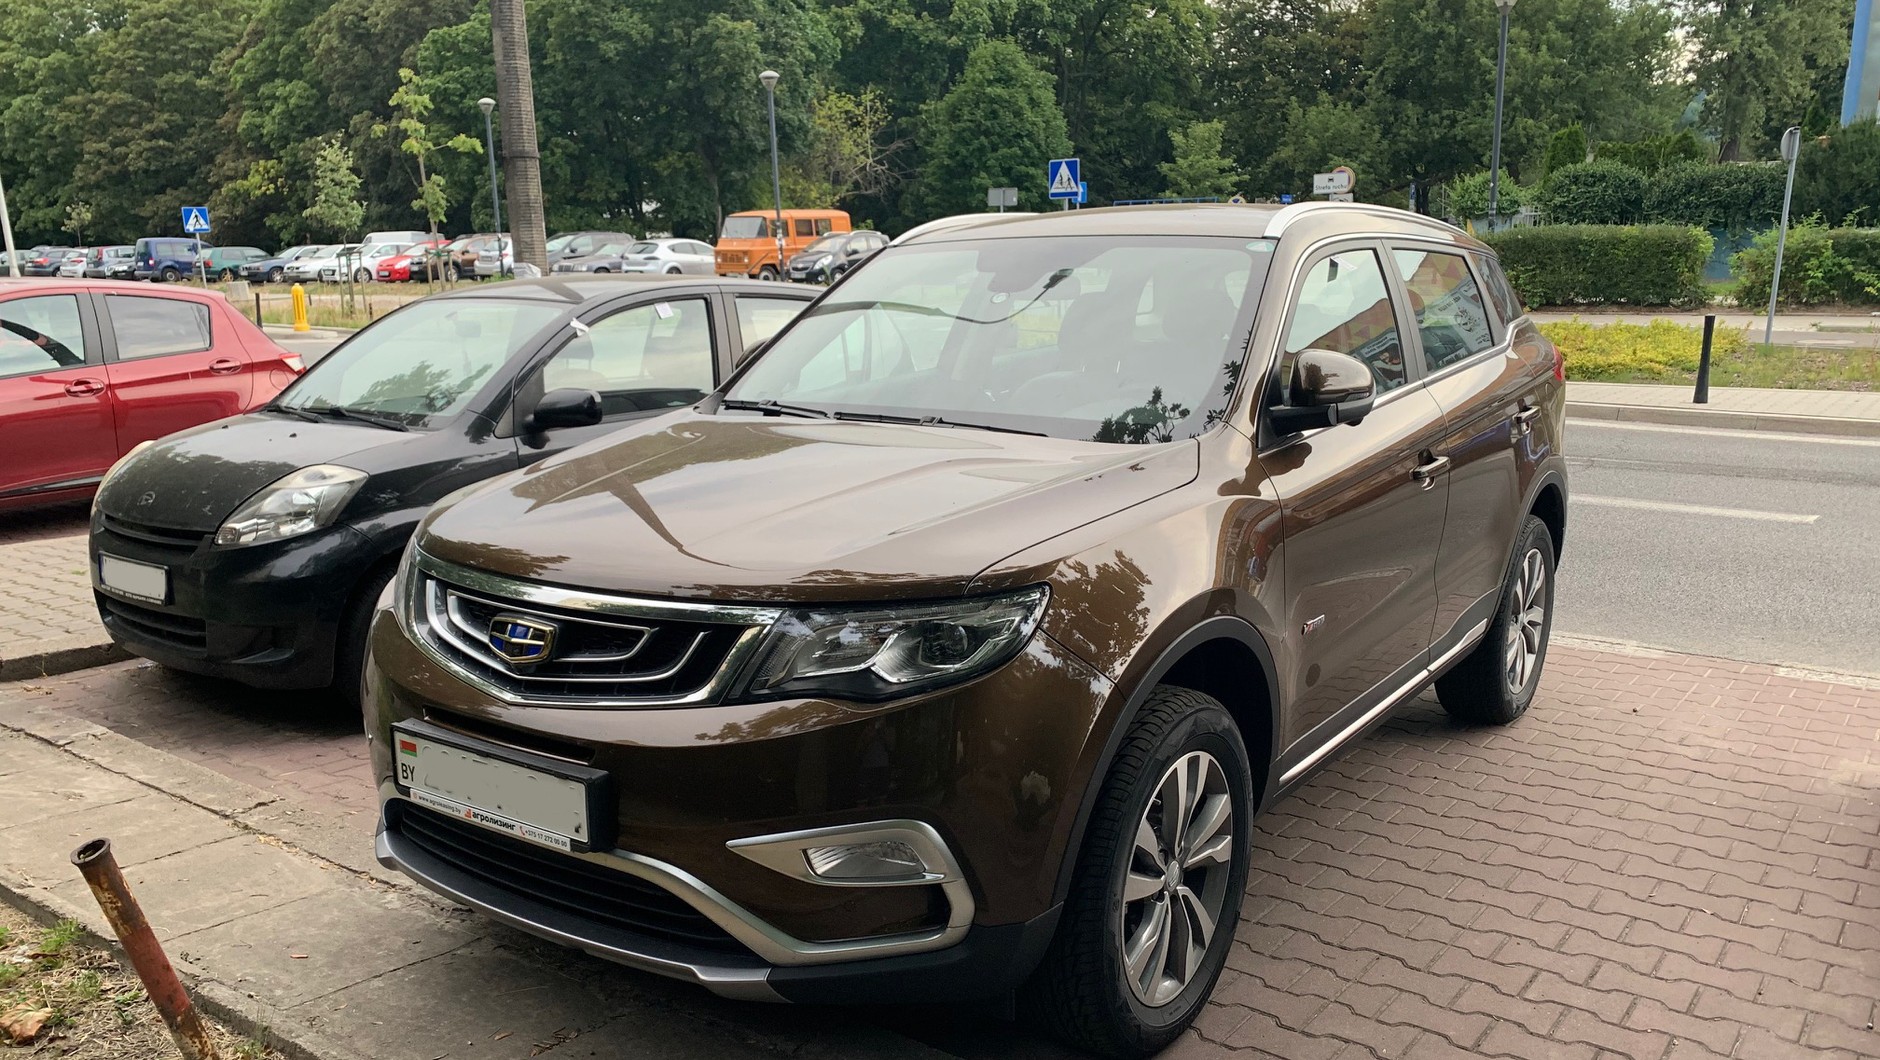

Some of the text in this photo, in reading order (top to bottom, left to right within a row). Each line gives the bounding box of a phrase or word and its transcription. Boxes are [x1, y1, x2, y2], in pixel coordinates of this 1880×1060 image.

[401, 762, 415, 782] BY
[418, 795, 461, 814] www.agroleasing.by
[472, 811, 516, 831] агролизинг
[525, 829, 537, 838] +375
[544, 835, 553, 843] 272
